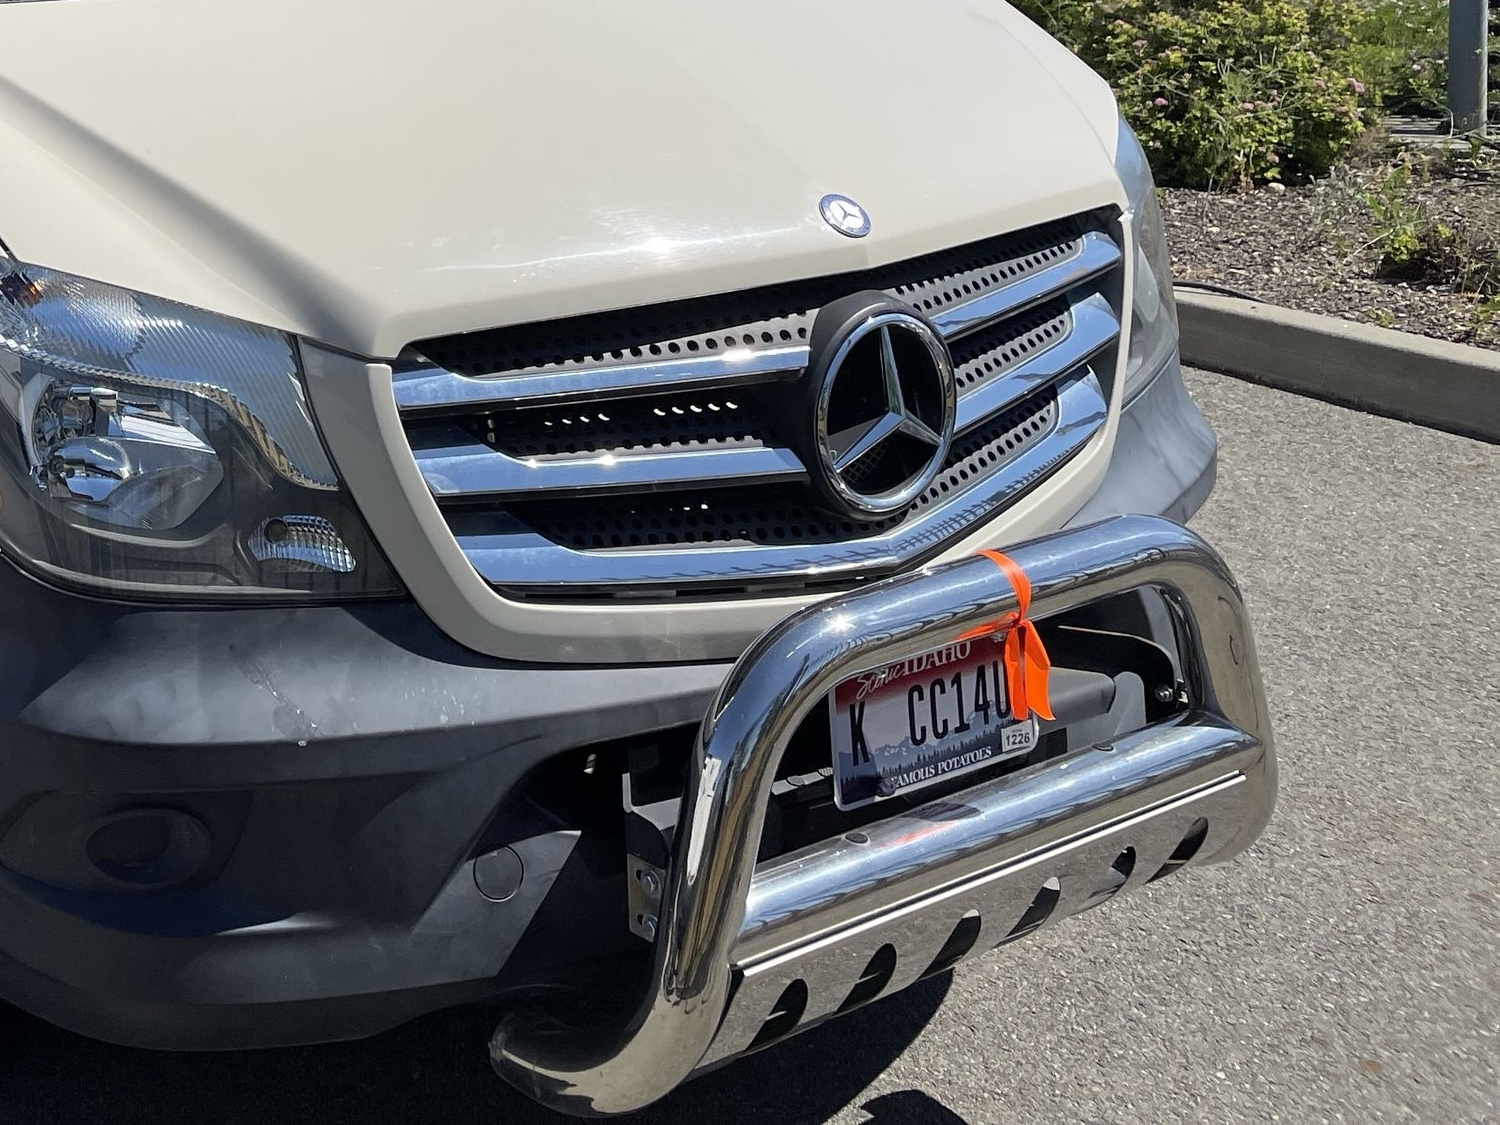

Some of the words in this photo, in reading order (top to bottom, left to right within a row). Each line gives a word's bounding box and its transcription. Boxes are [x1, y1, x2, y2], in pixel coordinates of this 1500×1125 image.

[901, 641, 971, 676] IDAHO
[850, 701, 870, 766] K
[1006, 733, 1031, 746] 1226
[937, 746, 992, 774] POTATOES
